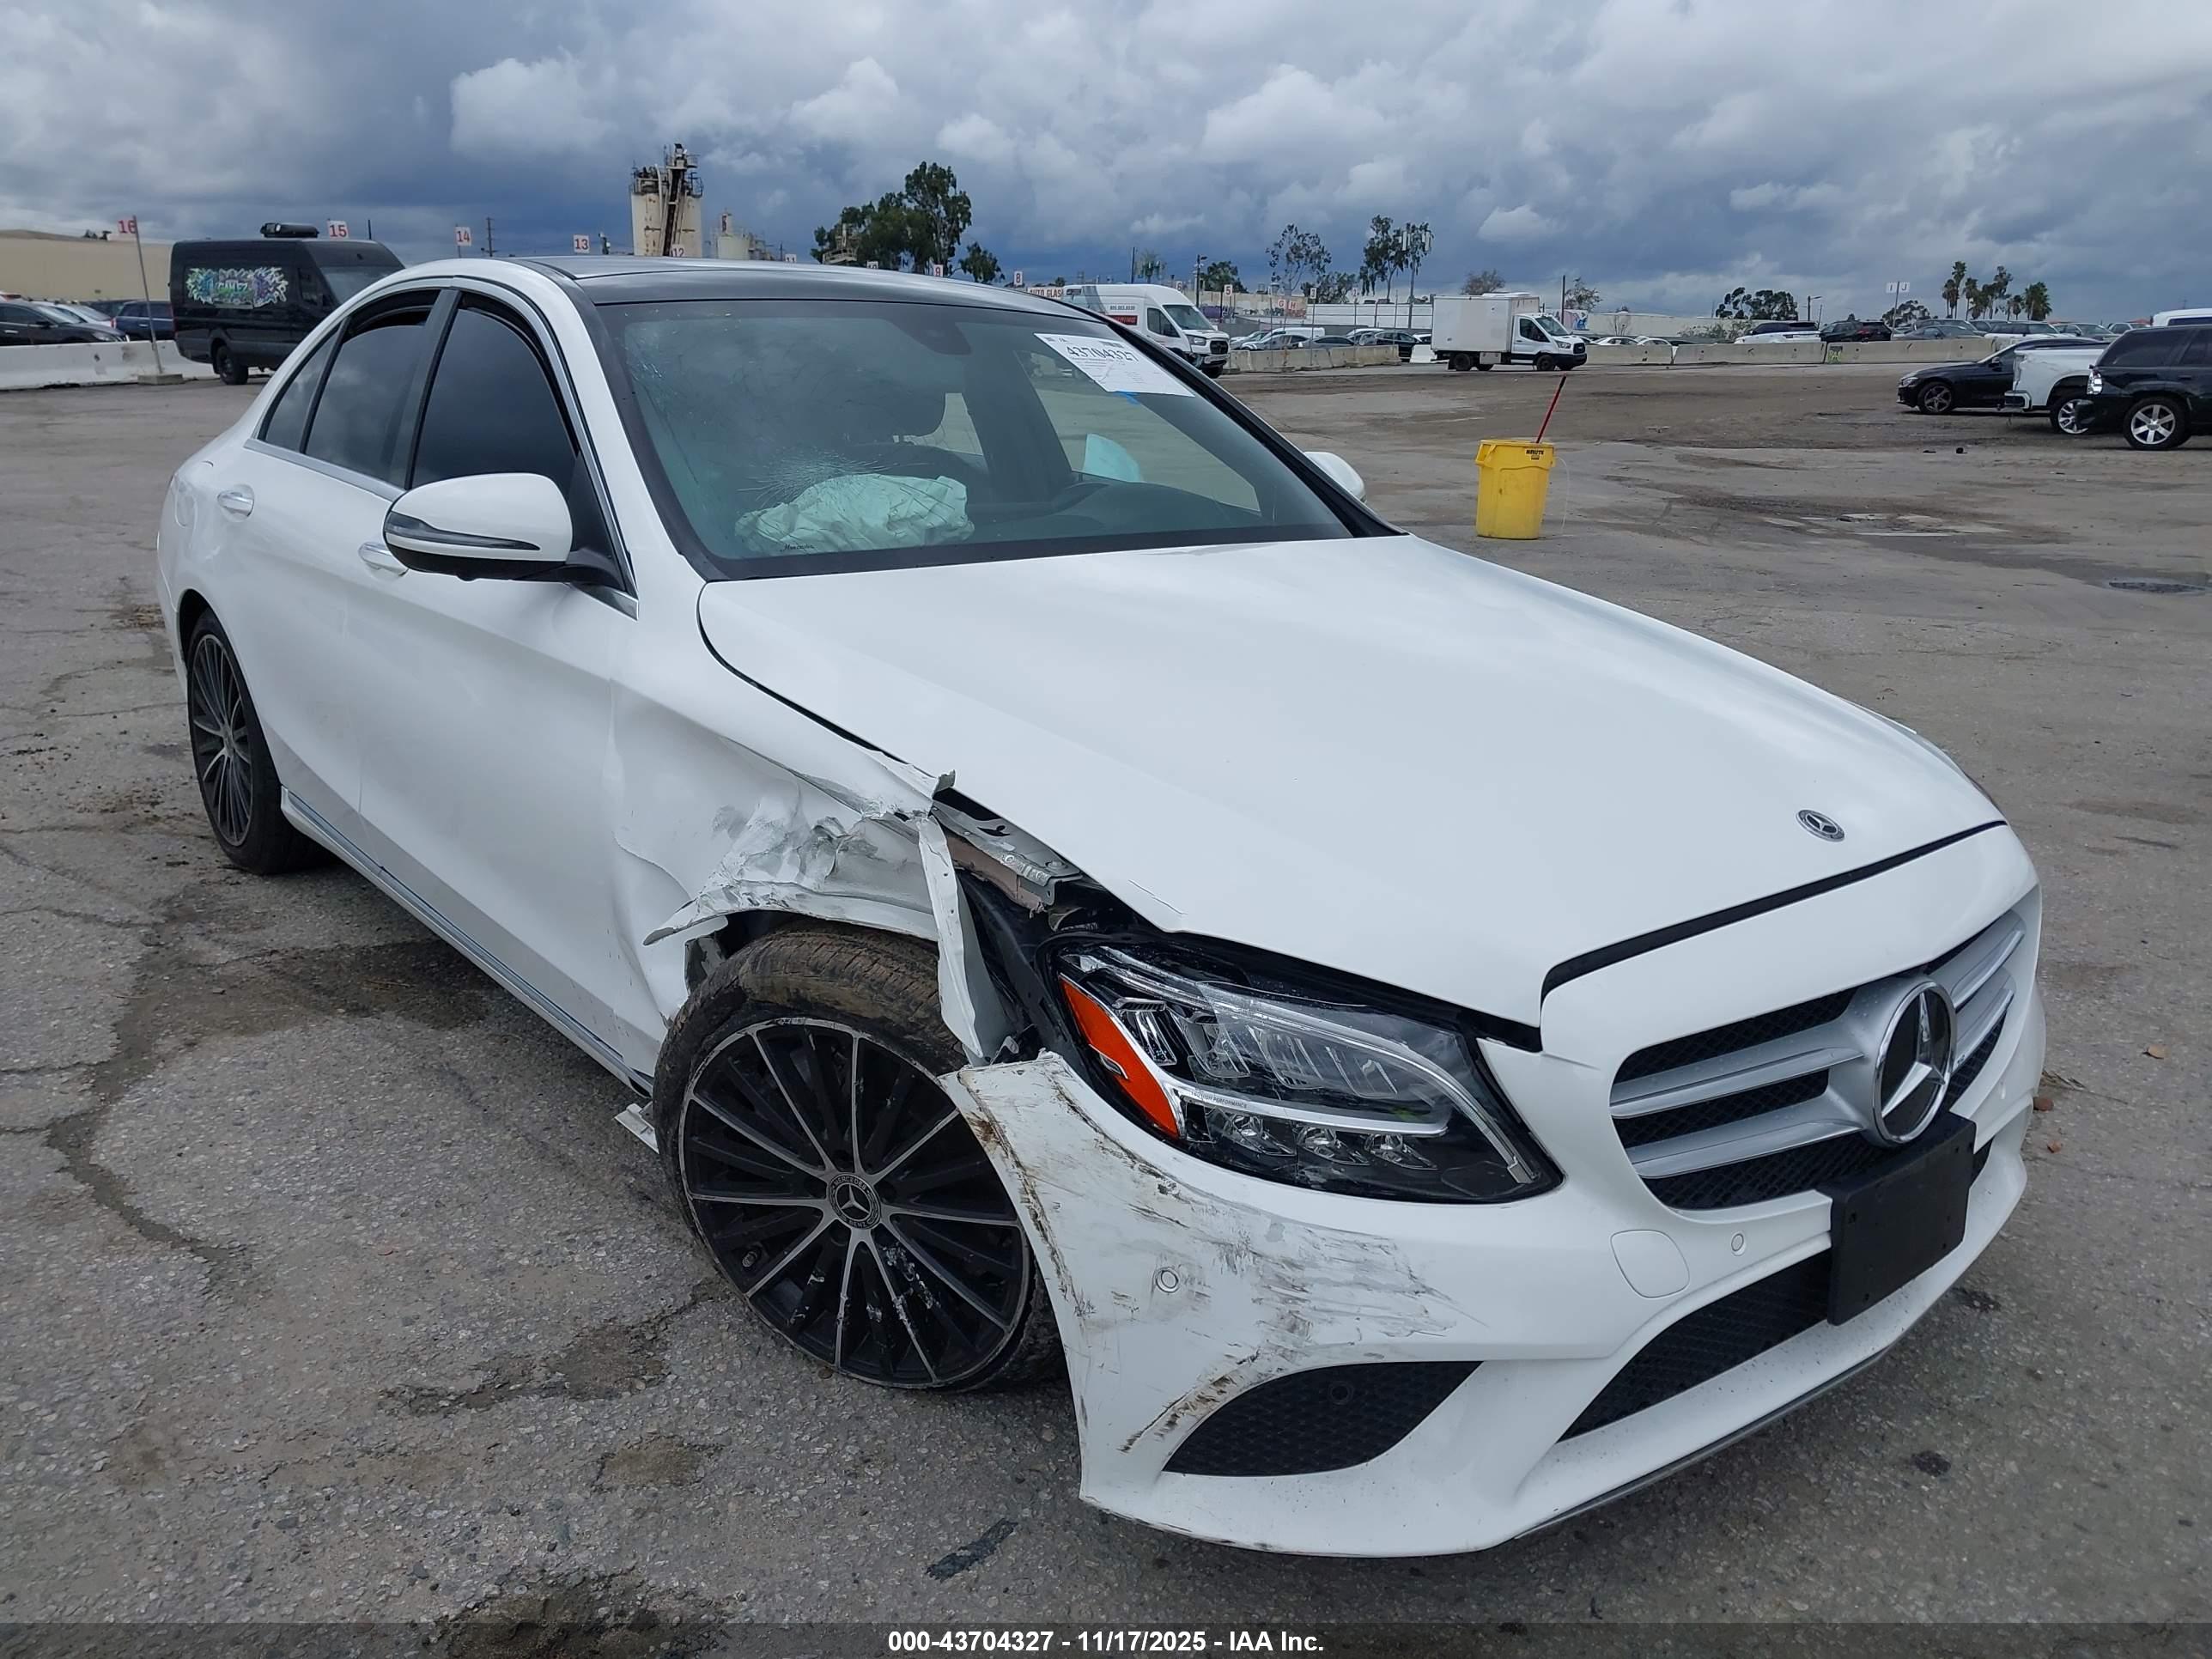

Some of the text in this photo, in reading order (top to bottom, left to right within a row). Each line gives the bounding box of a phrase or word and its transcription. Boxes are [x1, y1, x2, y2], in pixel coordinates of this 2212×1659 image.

[118, 220, 137, 234] 16
[330, 224, 347, 237] 15
[457, 230, 470, 242] 14
[575, 238, 588, 250] 13
[1225, 285, 1232, 295] 5
[1066, 346, 1139, 362] 43704327
[1212, 1097, 1248, 1109] PERFORMANCE
[833, 1176, 867, 1190] MERCEDES
